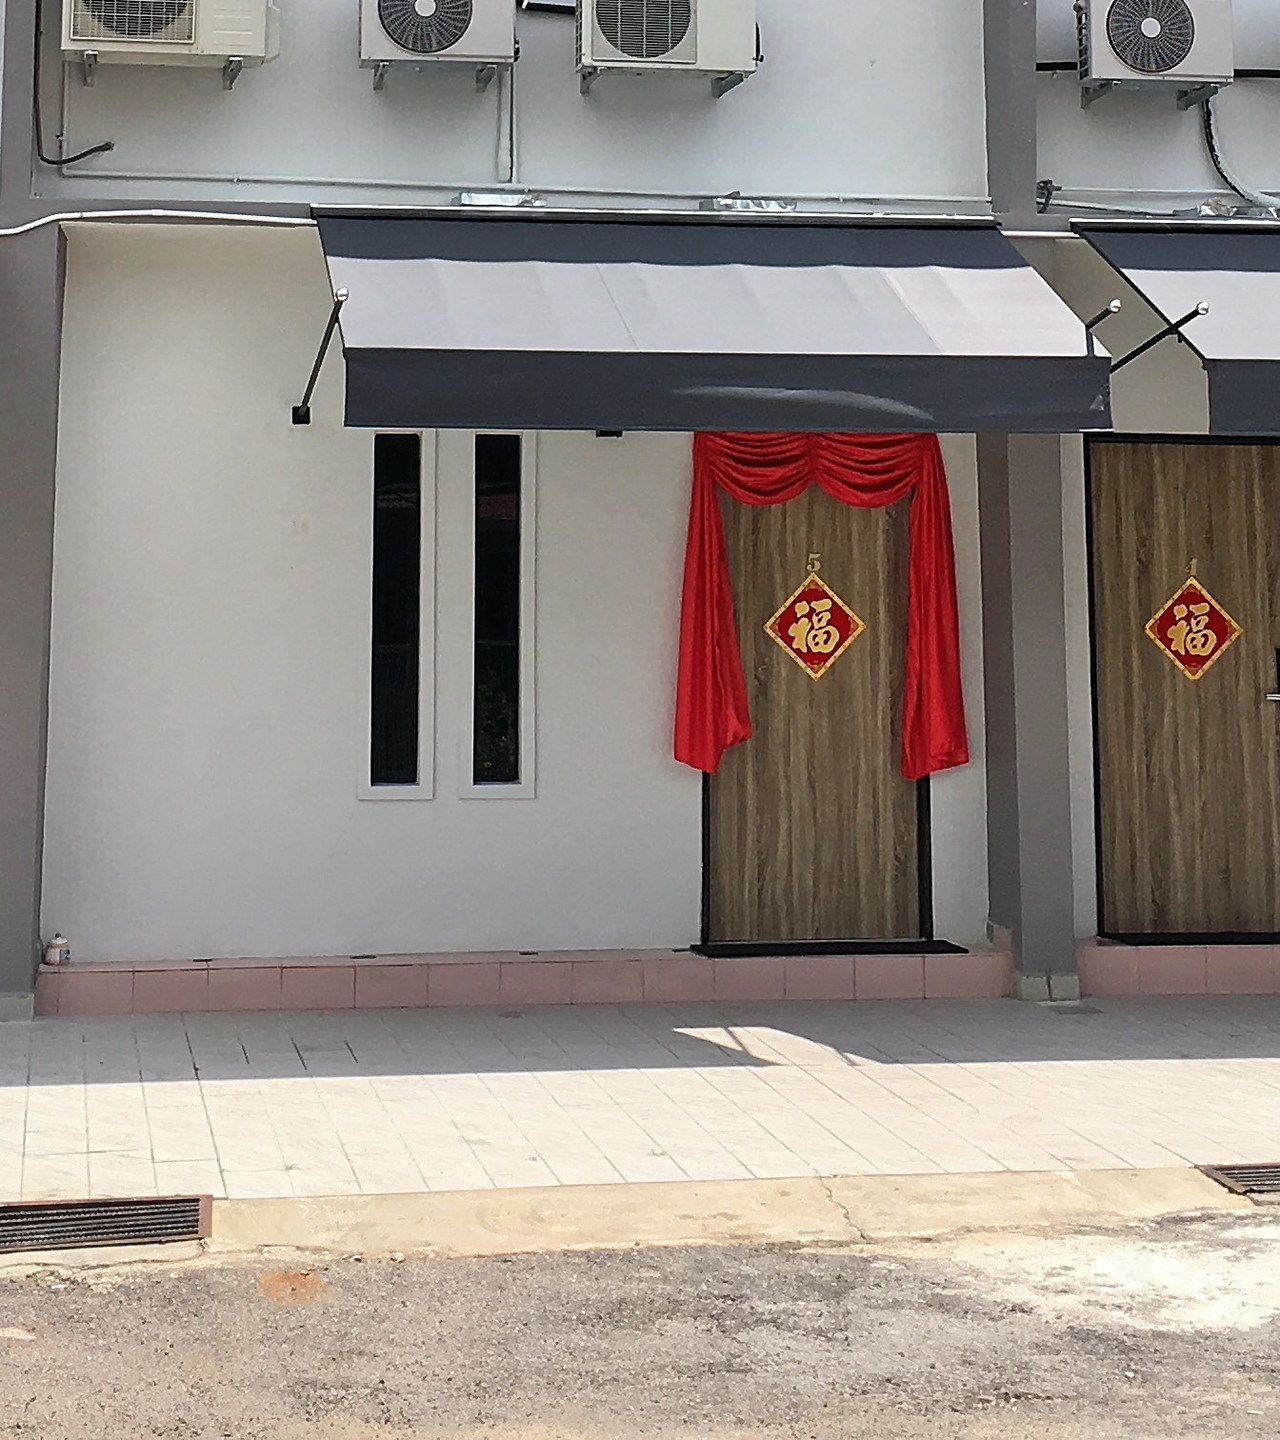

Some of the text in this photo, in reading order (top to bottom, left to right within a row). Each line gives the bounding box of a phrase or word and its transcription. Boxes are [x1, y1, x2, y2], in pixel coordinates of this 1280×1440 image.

[806, 553, 822, 572] 5
[788, 598, 840, 653] 福
[1167, 602, 1217, 656] 福
